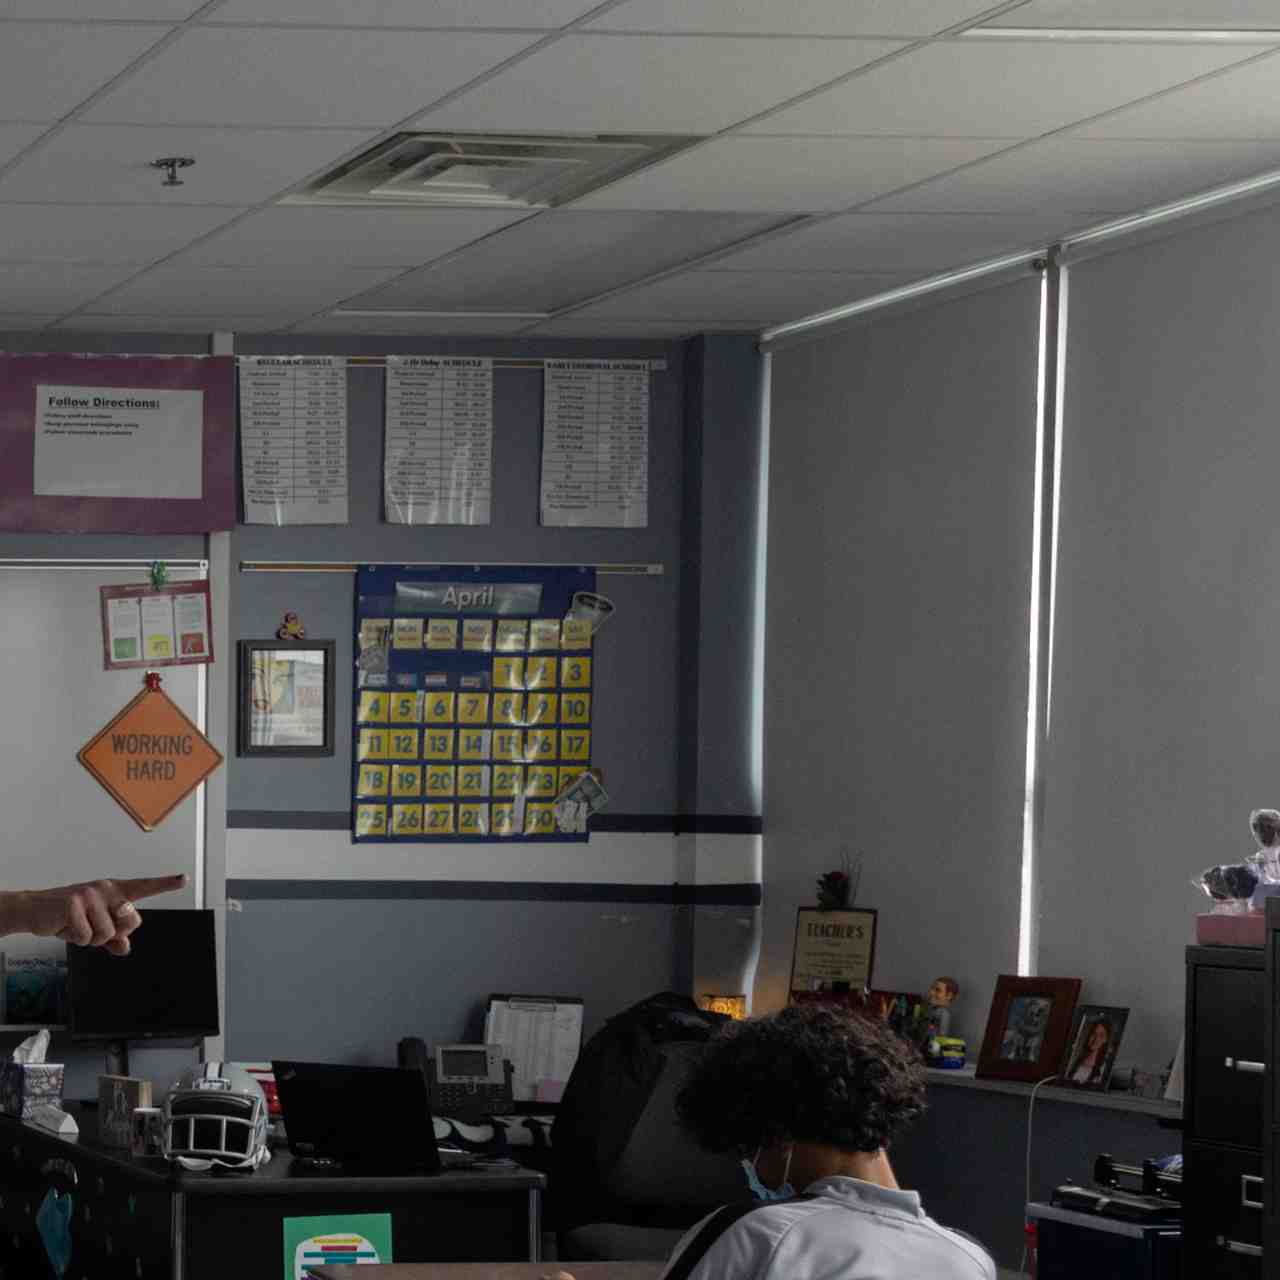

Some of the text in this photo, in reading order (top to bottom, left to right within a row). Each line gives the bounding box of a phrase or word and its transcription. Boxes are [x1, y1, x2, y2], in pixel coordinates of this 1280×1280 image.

[48, 397, 160, 409] Follow Directions:
[441, 586, 494, 609] April
[569, 662, 582, 682] 3
[369, 699, 381, 716] 4
[399, 699, 411, 716] 5
[433, 699, 445, 717] 6
[467, 699, 479, 717] 7
[567, 699, 585, 717] 10
[111, 734, 193, 756] WORKING
[367, 735, 382, 753] 11
[394, 735, 412, 753] 12
[429, 735, 448, 753] 13
[465, 735, 482, 753] 14
[567, 735, 584, 753] 17
[126, 759, 177, 781] HARD
[365, 771, 384, 788] 18
[397, 771, 415, 789] 19
[430, 771, 450, 789] 20
[397, 809, 418, 828] 26
[428, 809, 449, 828] 27
